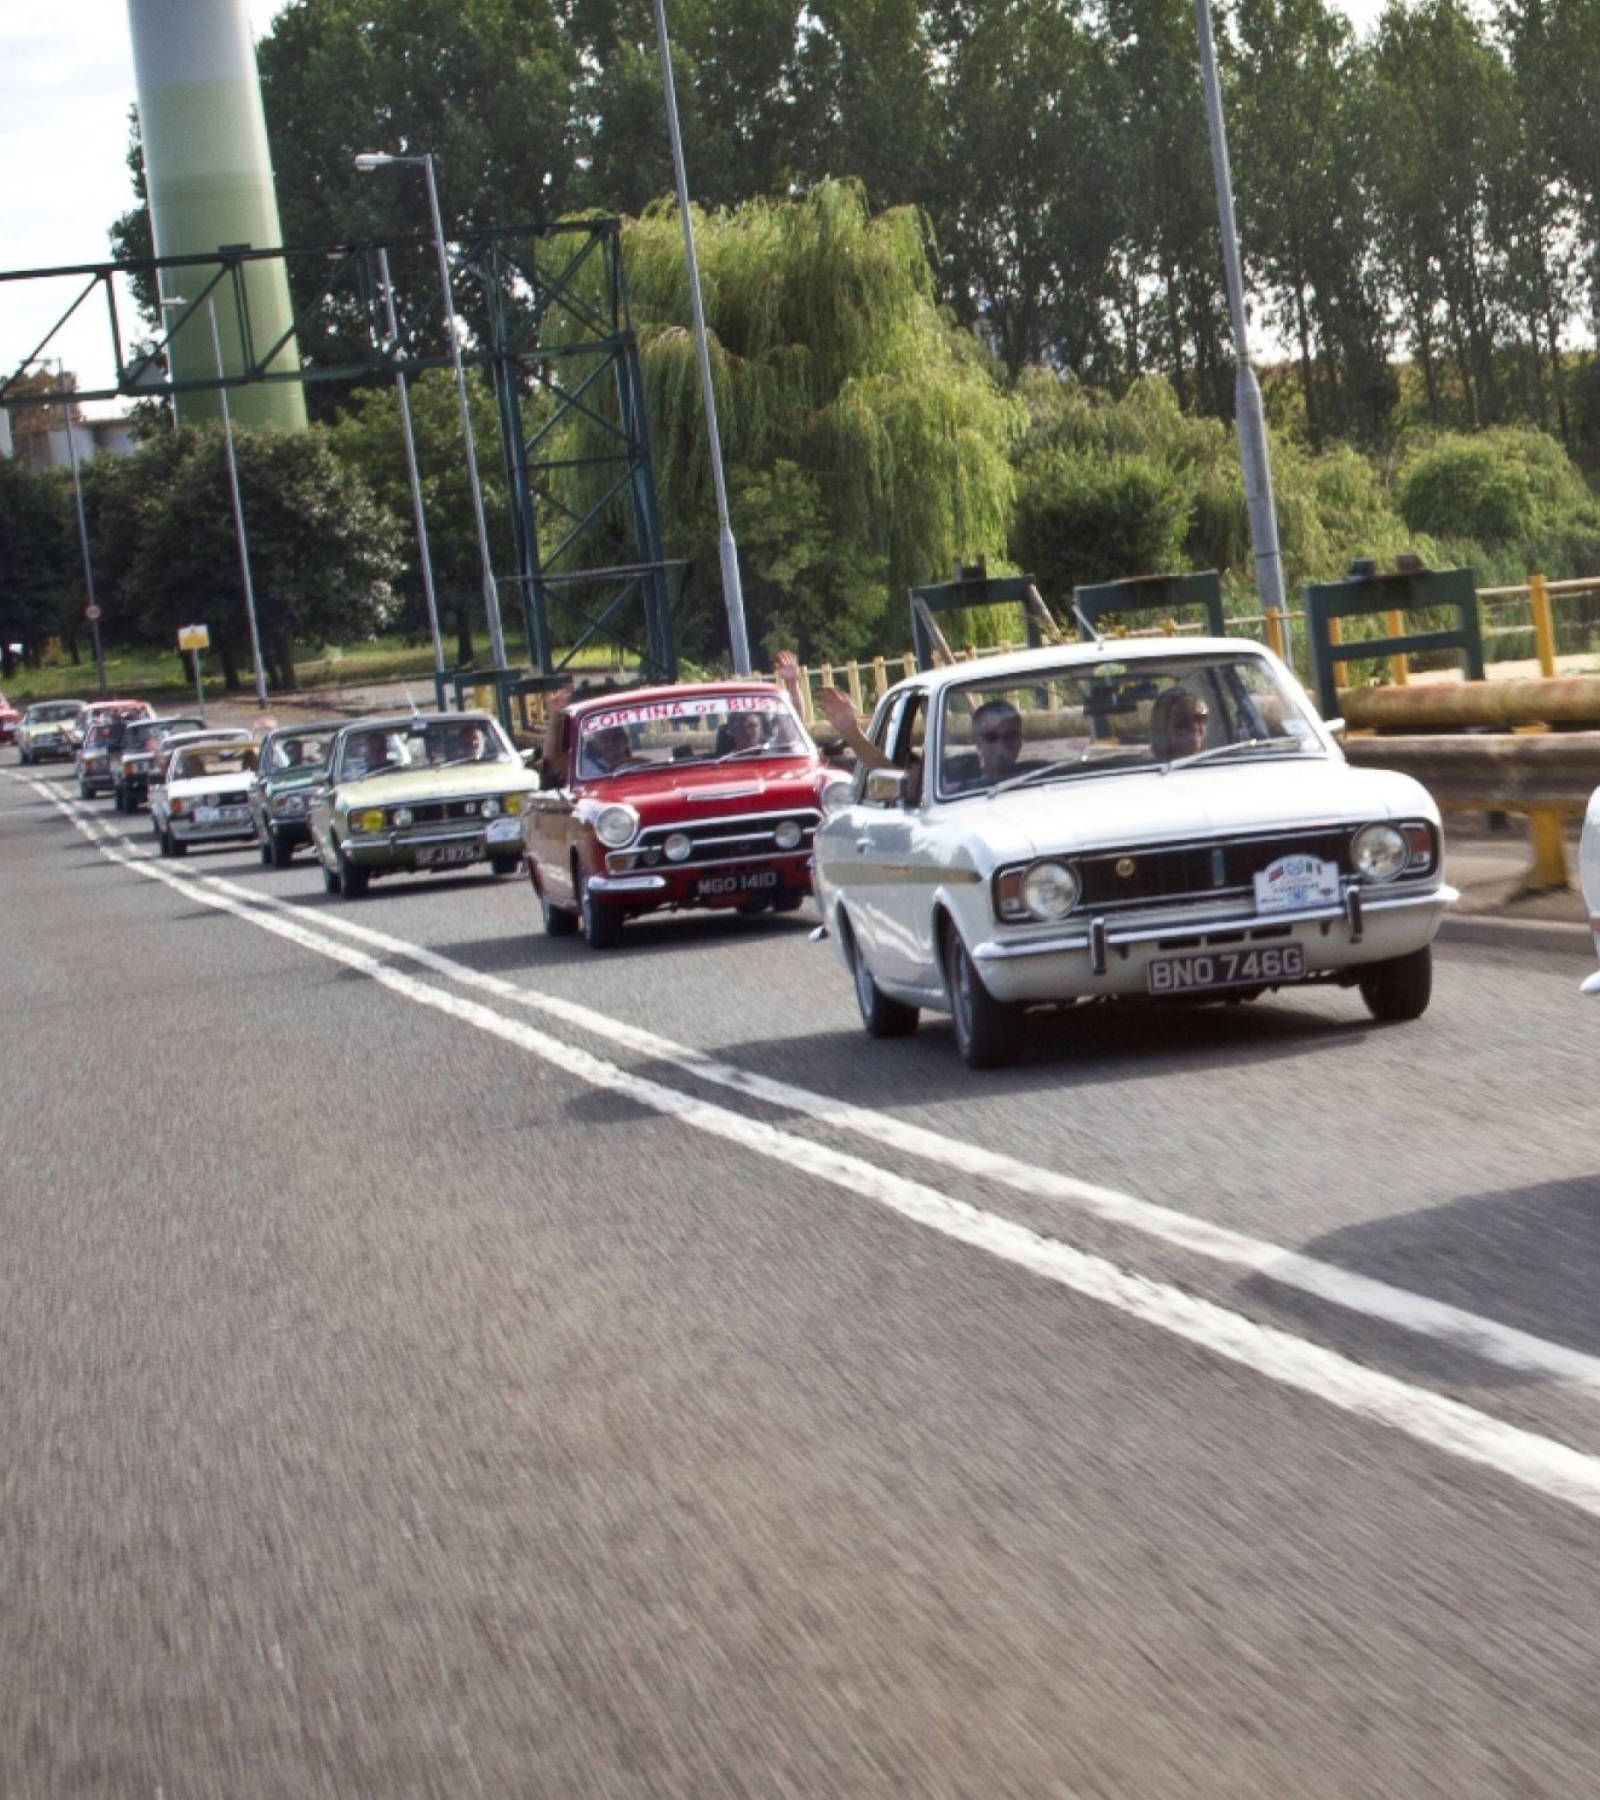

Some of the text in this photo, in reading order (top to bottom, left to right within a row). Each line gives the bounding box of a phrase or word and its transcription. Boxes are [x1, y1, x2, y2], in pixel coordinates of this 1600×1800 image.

[583, 703, 684, 733] CORTINA
[727, 697, 784, 715] BUST
[698, 876, 738, 894] MGO
[1151, 947, 1304, 989] BNO 746G
